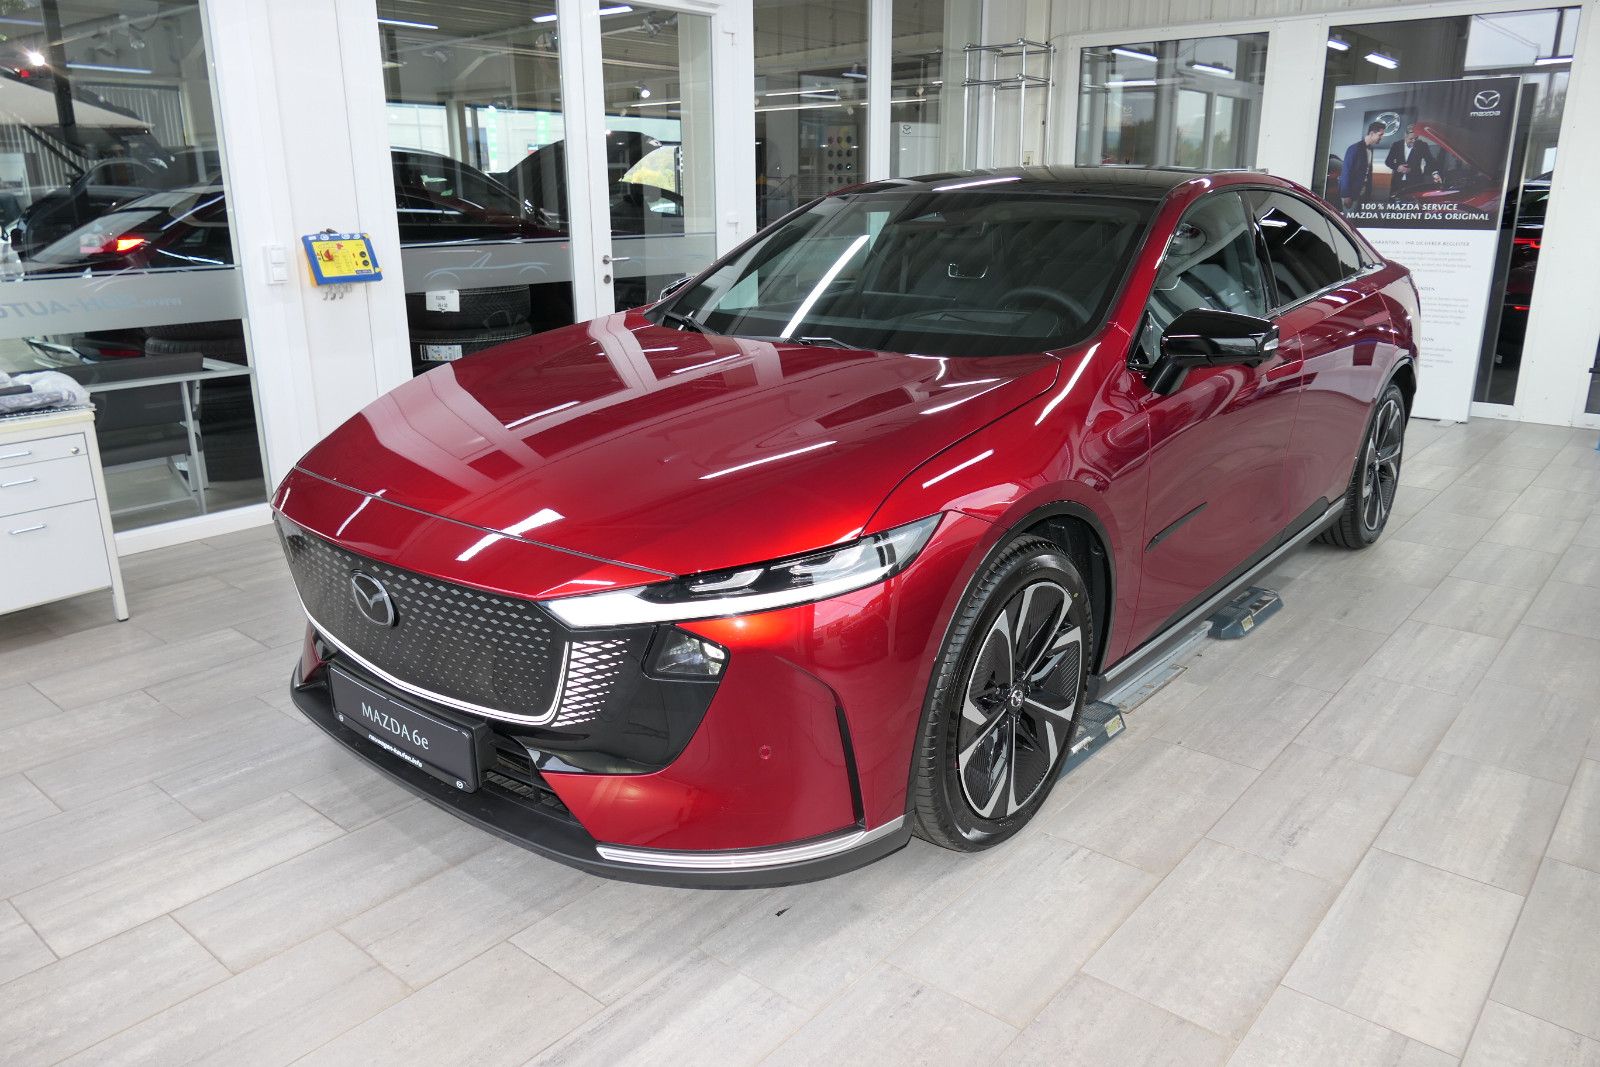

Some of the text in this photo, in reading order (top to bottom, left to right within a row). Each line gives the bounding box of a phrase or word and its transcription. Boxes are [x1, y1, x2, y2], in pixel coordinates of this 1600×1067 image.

[1387, 203, 1420, 211] MAZDA
[1422, 203, 1459, 211] SERVICE
[1380, 212, 1423, 220] VERDIENT
[1424, 212, 1442, 220] DAS
[1444, 213, 1490, 221] ORIGINAL
[361, 701, 429, 750] MAZDA 6e
